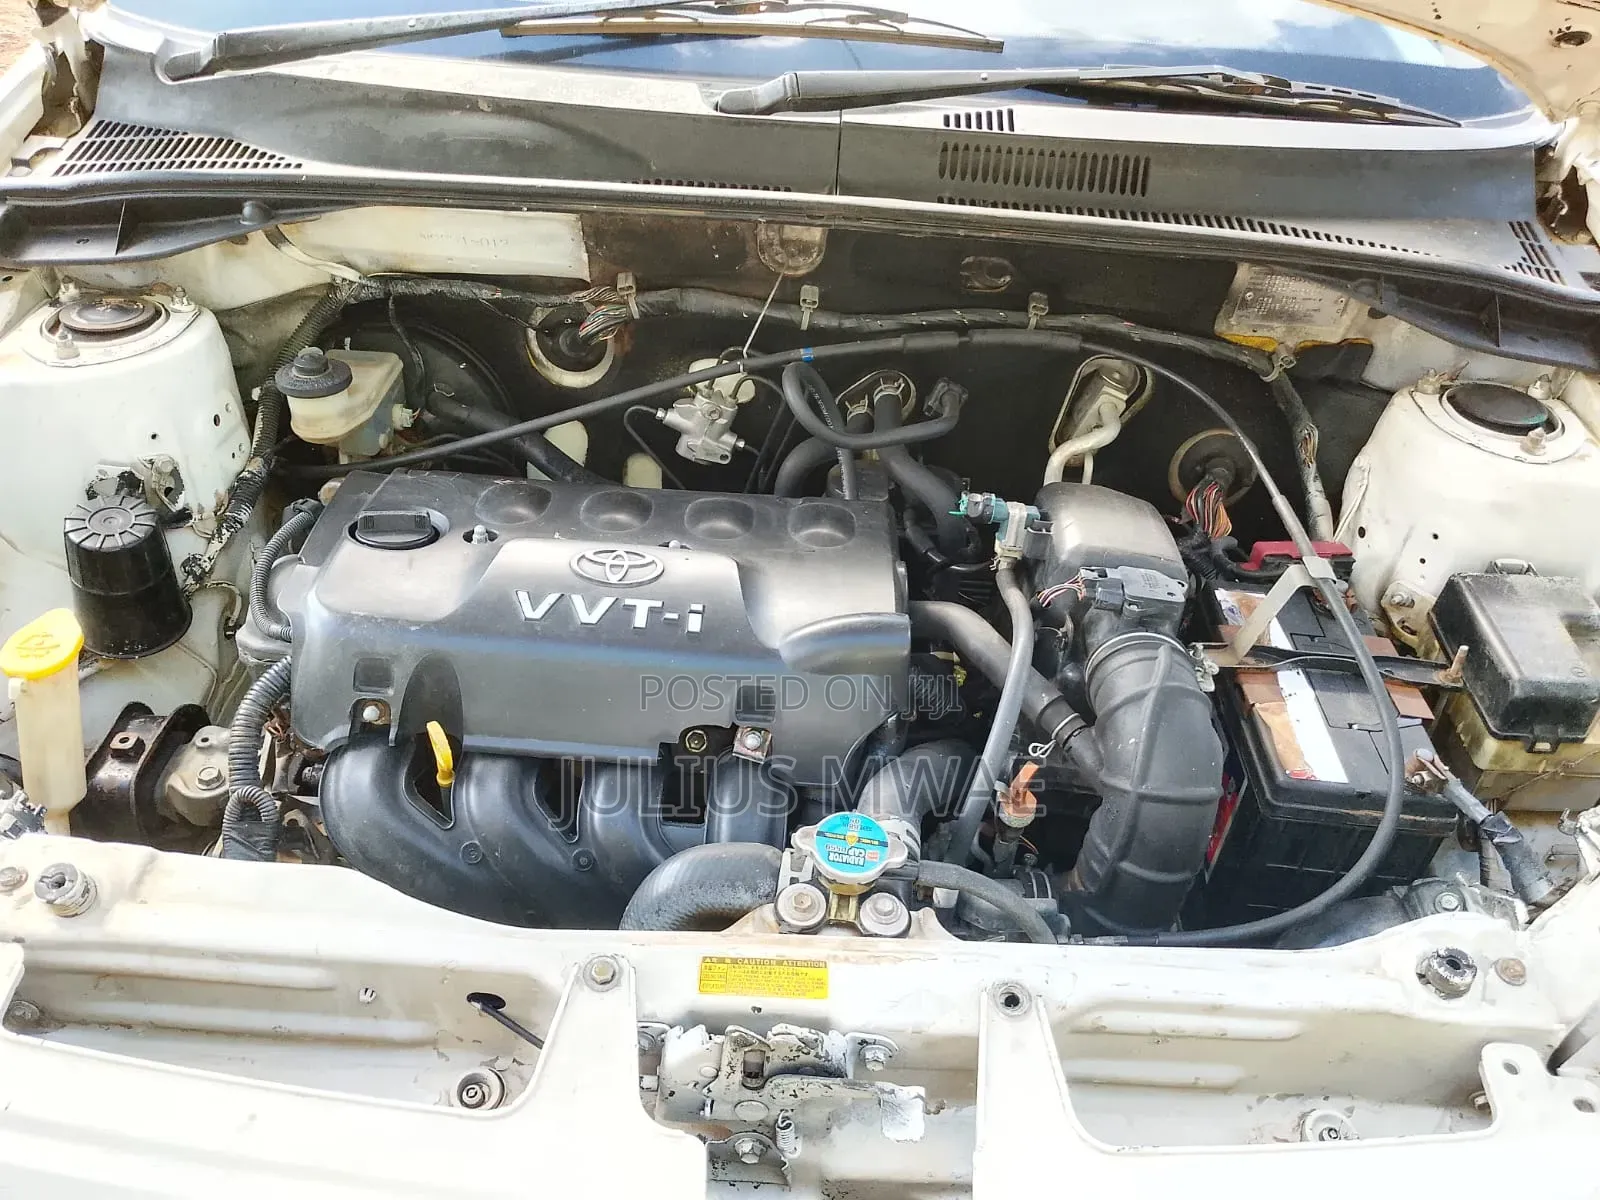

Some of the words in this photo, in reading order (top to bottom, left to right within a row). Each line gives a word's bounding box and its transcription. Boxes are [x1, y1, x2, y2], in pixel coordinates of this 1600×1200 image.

[516, 589, 705, 633] VVT-i
[828, 851, 865, 867] RADIATOR
[847, 846, 866, 858] CAP
[737, 958, 777, 966] CAUTION
[782, 960, 827, 969] ATTENTION
